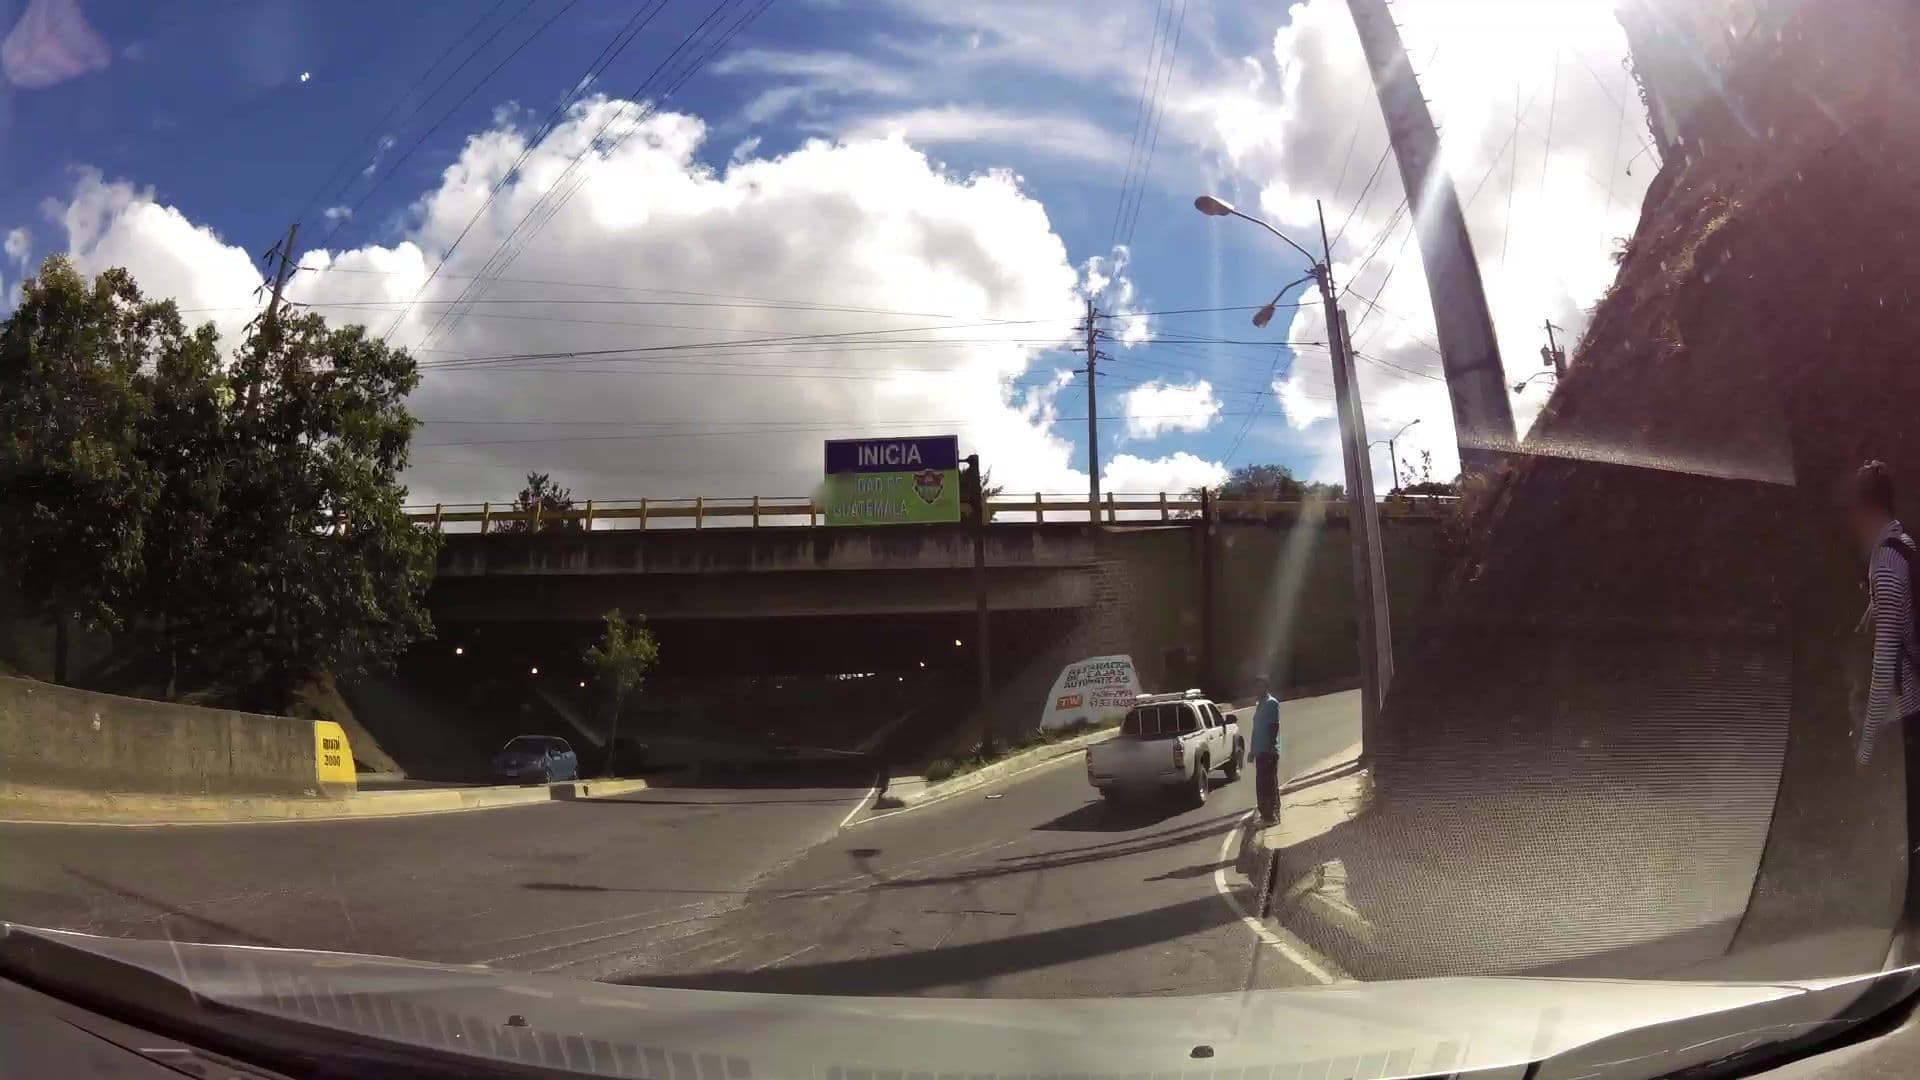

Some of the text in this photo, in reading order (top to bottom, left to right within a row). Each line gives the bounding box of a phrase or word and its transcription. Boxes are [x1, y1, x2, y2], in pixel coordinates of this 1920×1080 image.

[858, 443, 922, 466] INICIA
[832, 499, 910, 517] GUATEMALA
[324, 753, 340, 766] 2000
